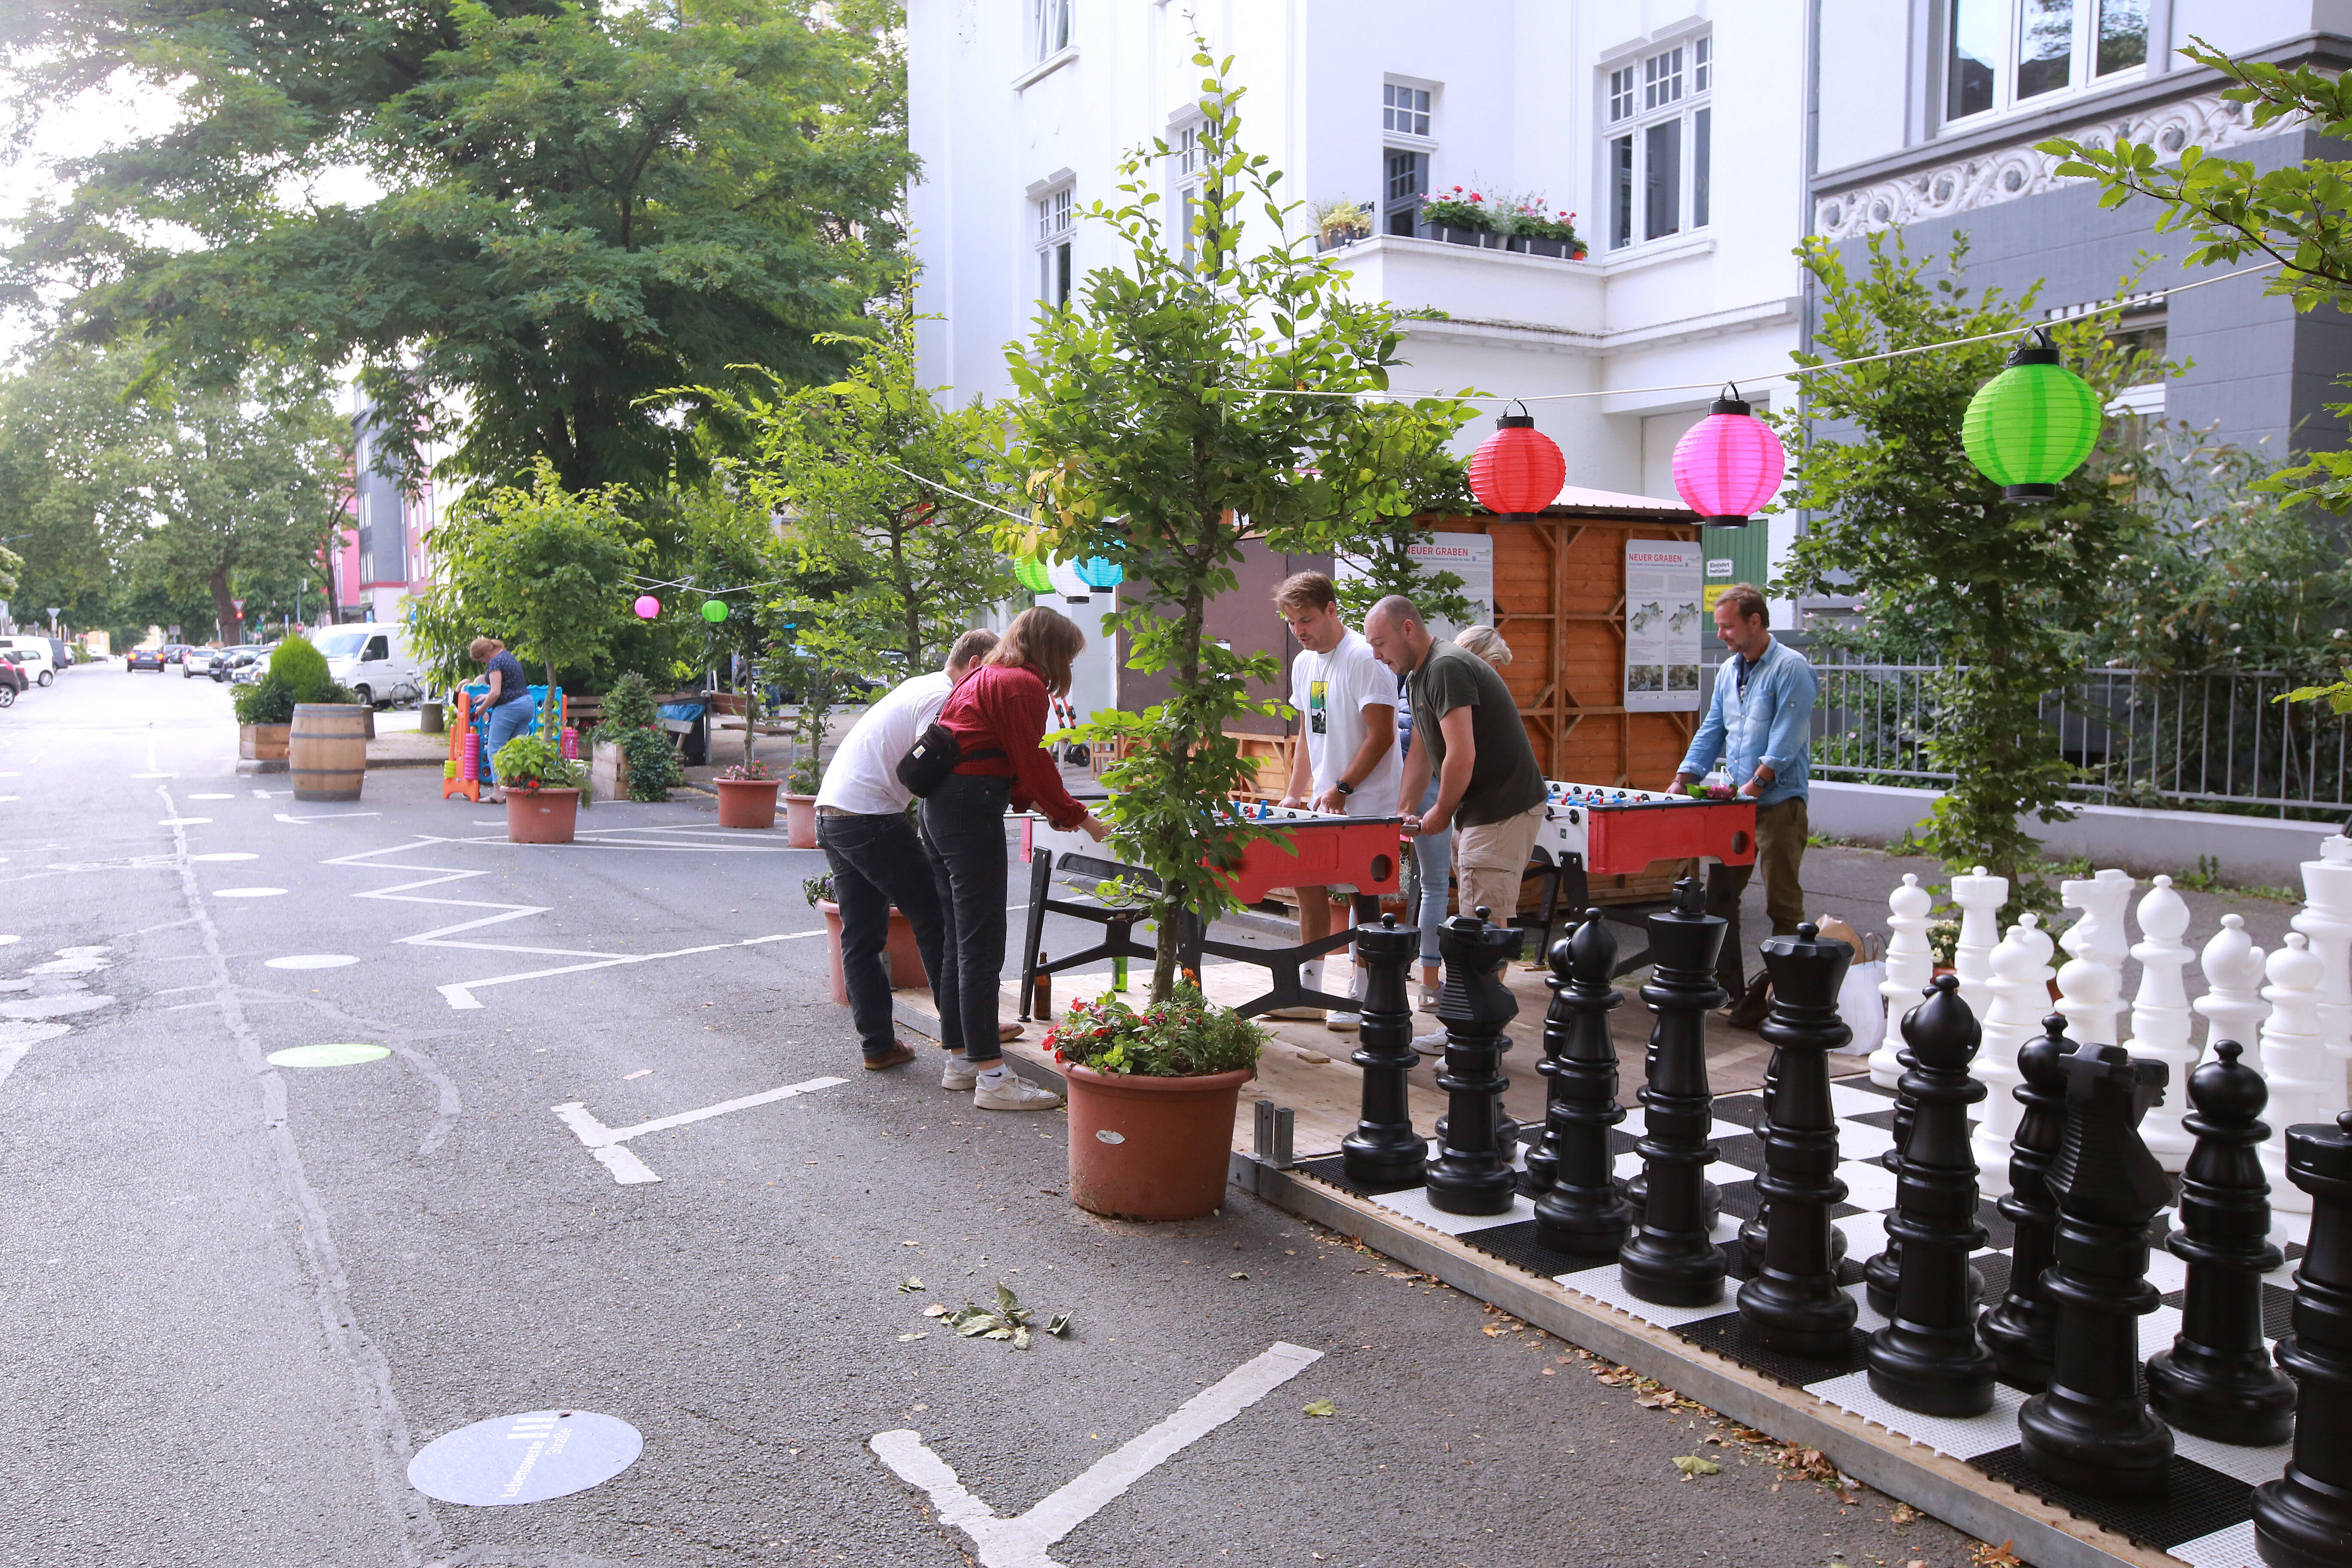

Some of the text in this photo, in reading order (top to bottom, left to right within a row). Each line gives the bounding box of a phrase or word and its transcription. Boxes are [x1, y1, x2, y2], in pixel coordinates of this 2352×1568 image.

[1406, 546, 1468, 556] NEUER GRABEN
[1629, 553, 1652, 561] NEUER
[1654, 554, 1682, 563] GRABEN
[545, 1427, 573, 1455] Straße
[500, 1440, 545, 1498] Lebenswerte
